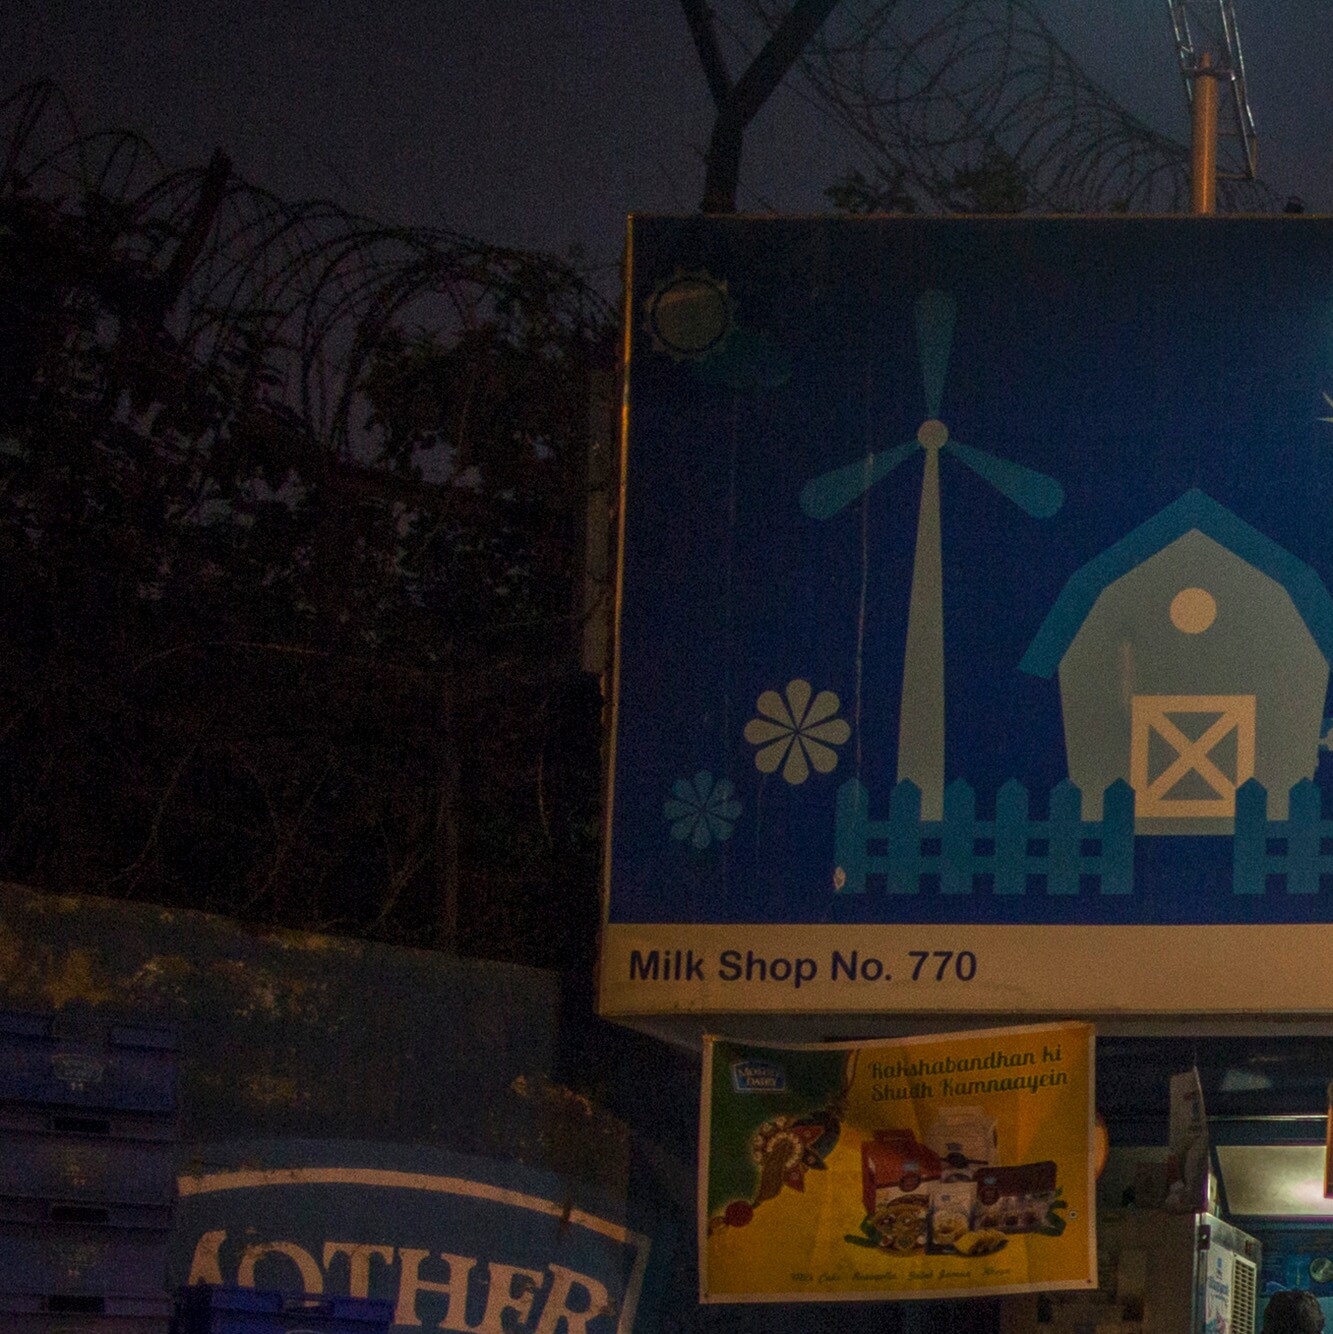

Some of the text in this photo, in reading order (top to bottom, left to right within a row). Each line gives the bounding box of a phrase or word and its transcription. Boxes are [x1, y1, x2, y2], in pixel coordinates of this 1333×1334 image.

[628, 949, 977, 989] Milk Shop No. 770
[869, 1050, 1036, 1079] Rakshabandhan
[871, 1069, 1068, 1101] Shudh Kamnaayein
